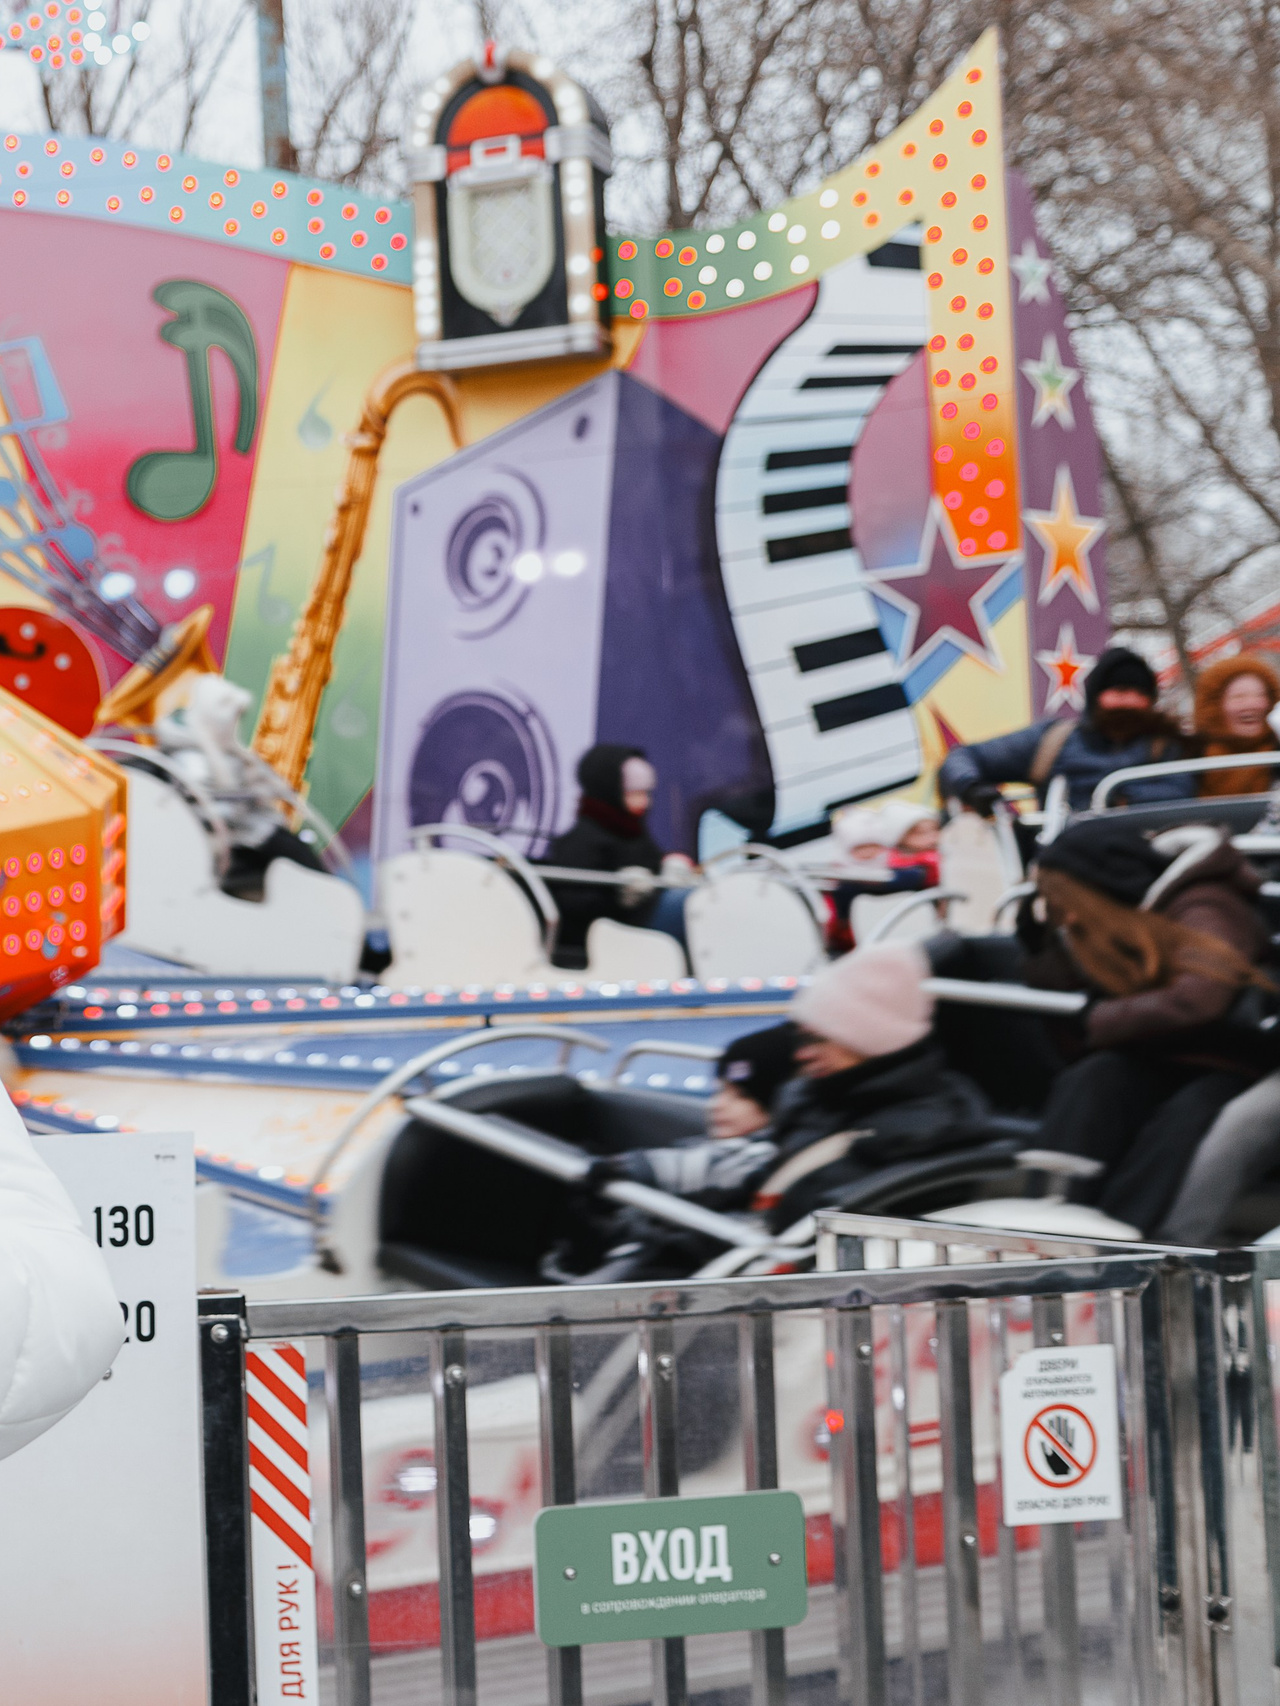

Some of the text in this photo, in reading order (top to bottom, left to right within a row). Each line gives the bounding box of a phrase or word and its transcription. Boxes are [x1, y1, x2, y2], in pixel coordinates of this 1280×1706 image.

[93, 1204, 154, 1248] 130
[611, 1525, 732, 1585] ВХОД
[277, 1579, 300, 1632] РУК
[580, 1588, 767, 1614] в сопровождении оператора
[279, 1641, 305, 1699] ДЛЯ
